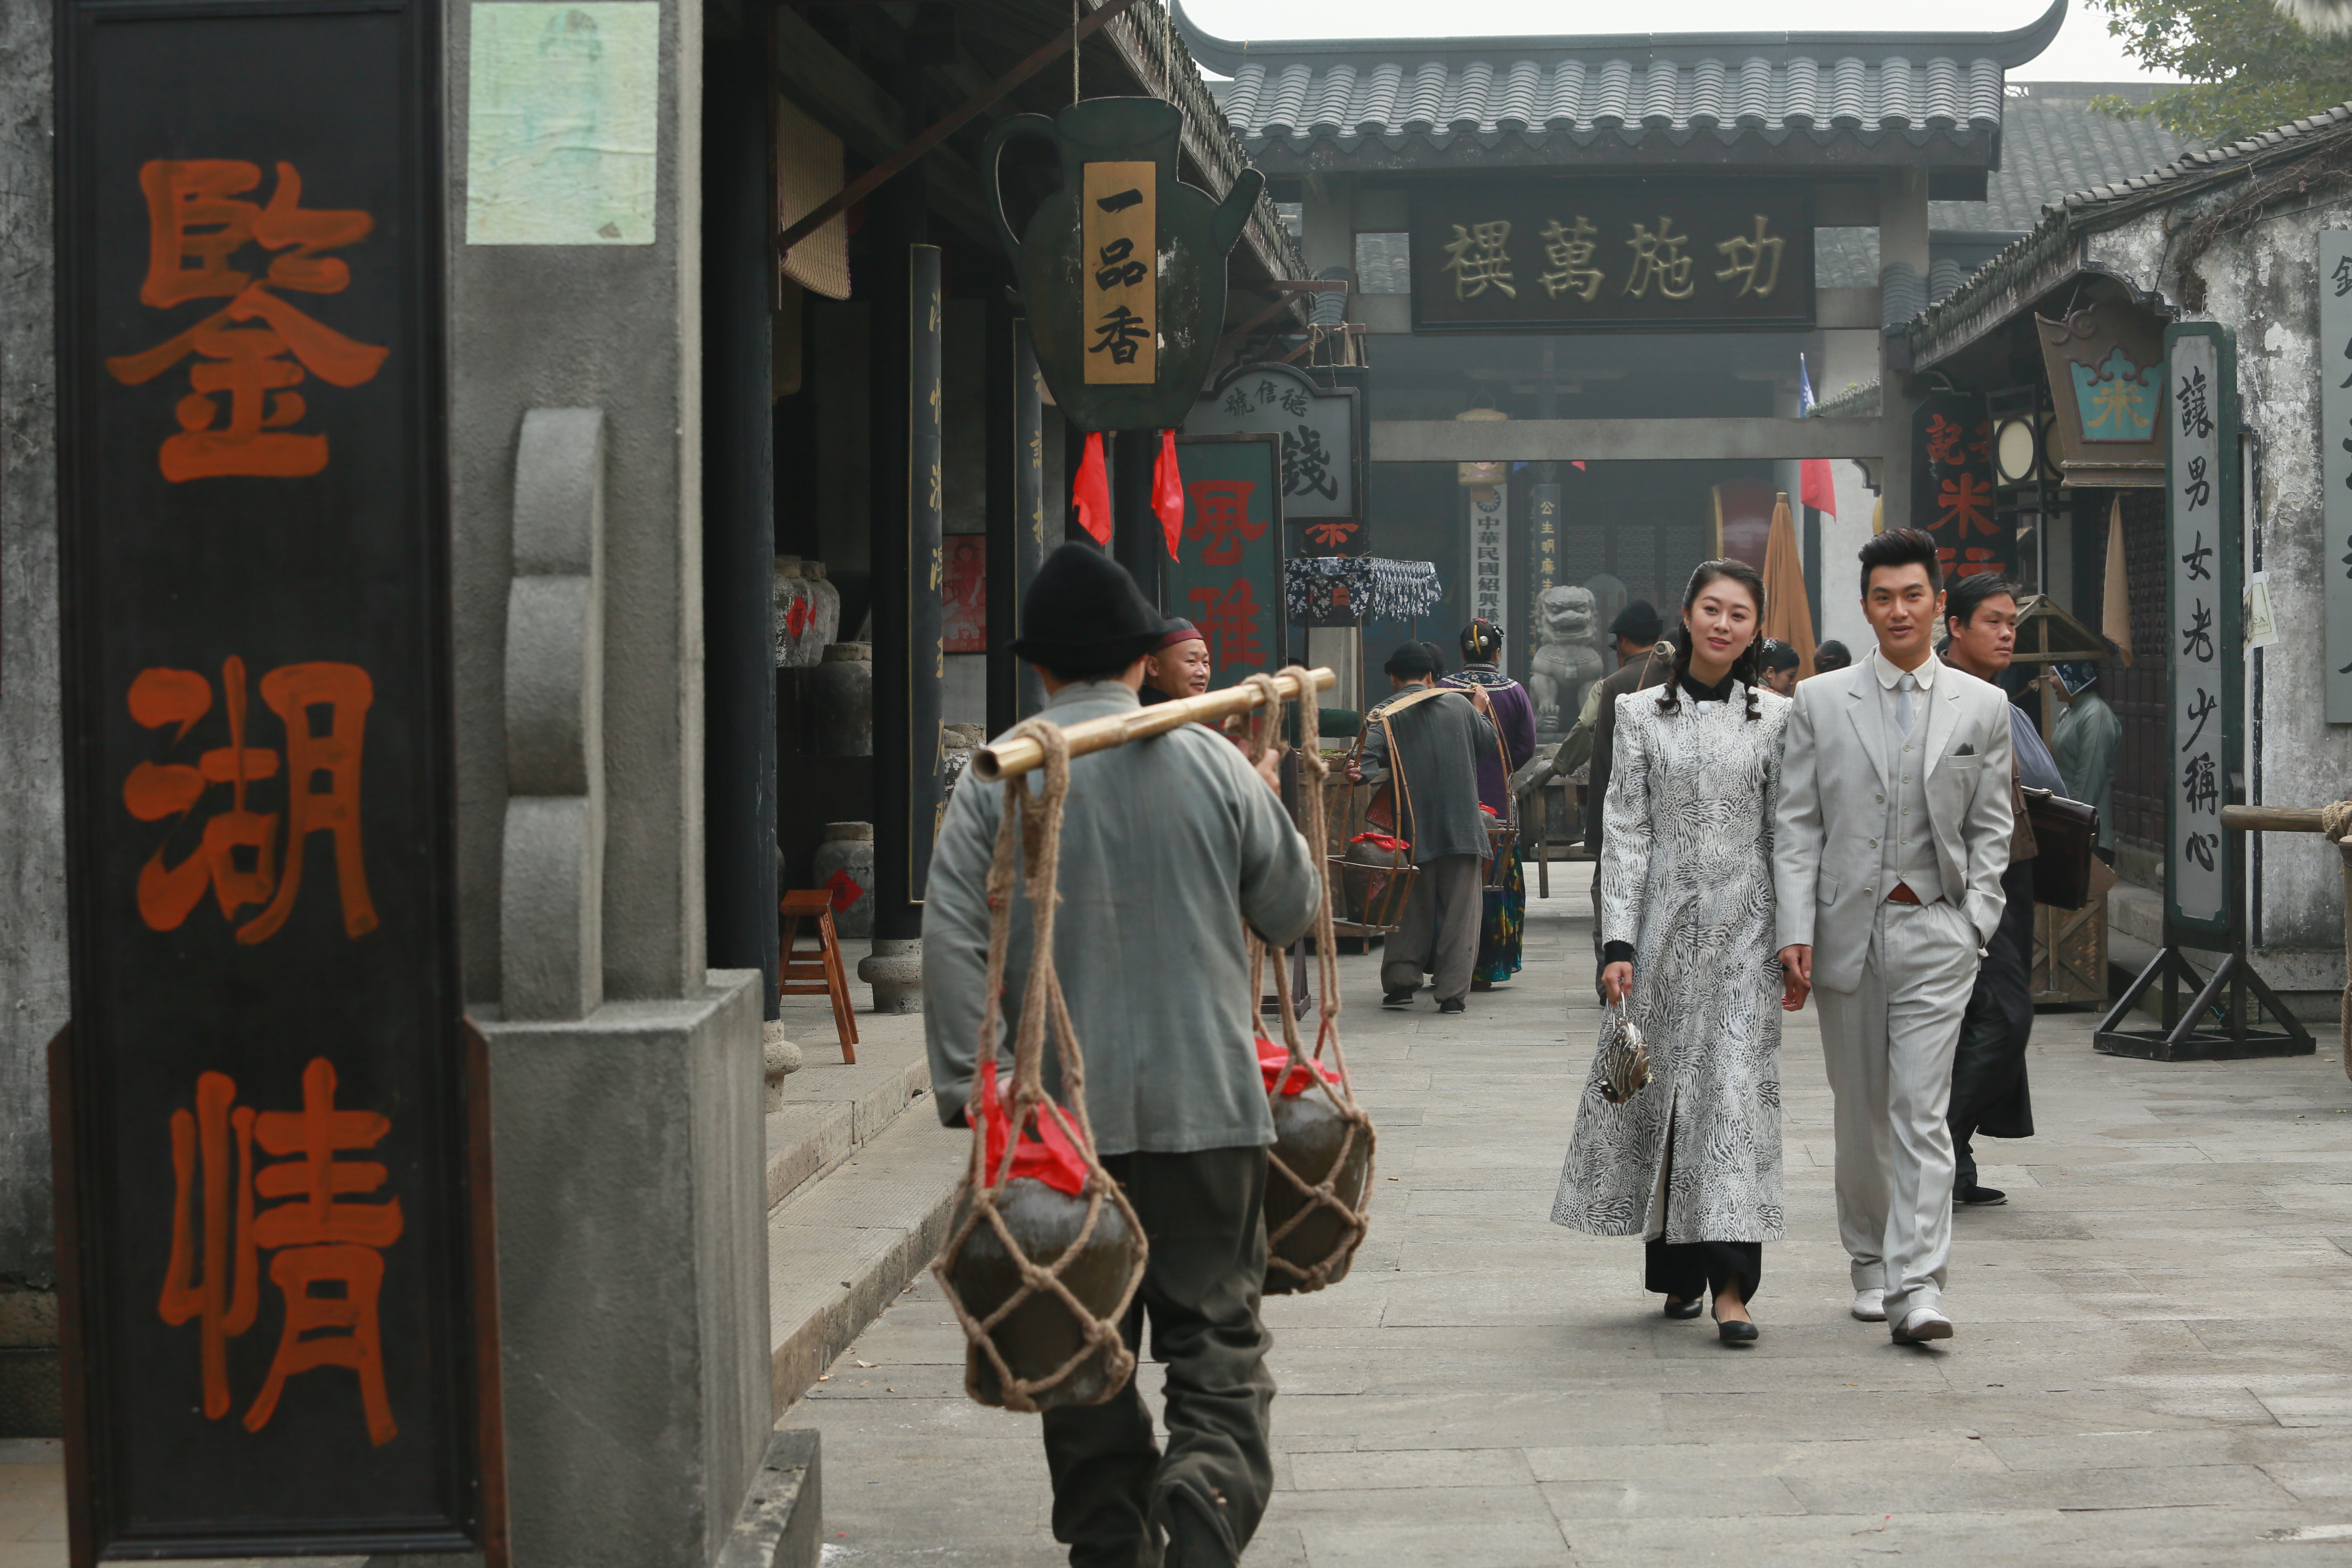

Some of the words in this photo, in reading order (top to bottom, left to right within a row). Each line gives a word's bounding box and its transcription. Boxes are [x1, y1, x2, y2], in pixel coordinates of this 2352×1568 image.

[1087, 188, 1151, 365] 一品香
[2087, 380, 2151, 430] 米
[1185, 480, 1268, 673] 風雅
[1477, 516, 1500, 624] 中華民國紹興縣
